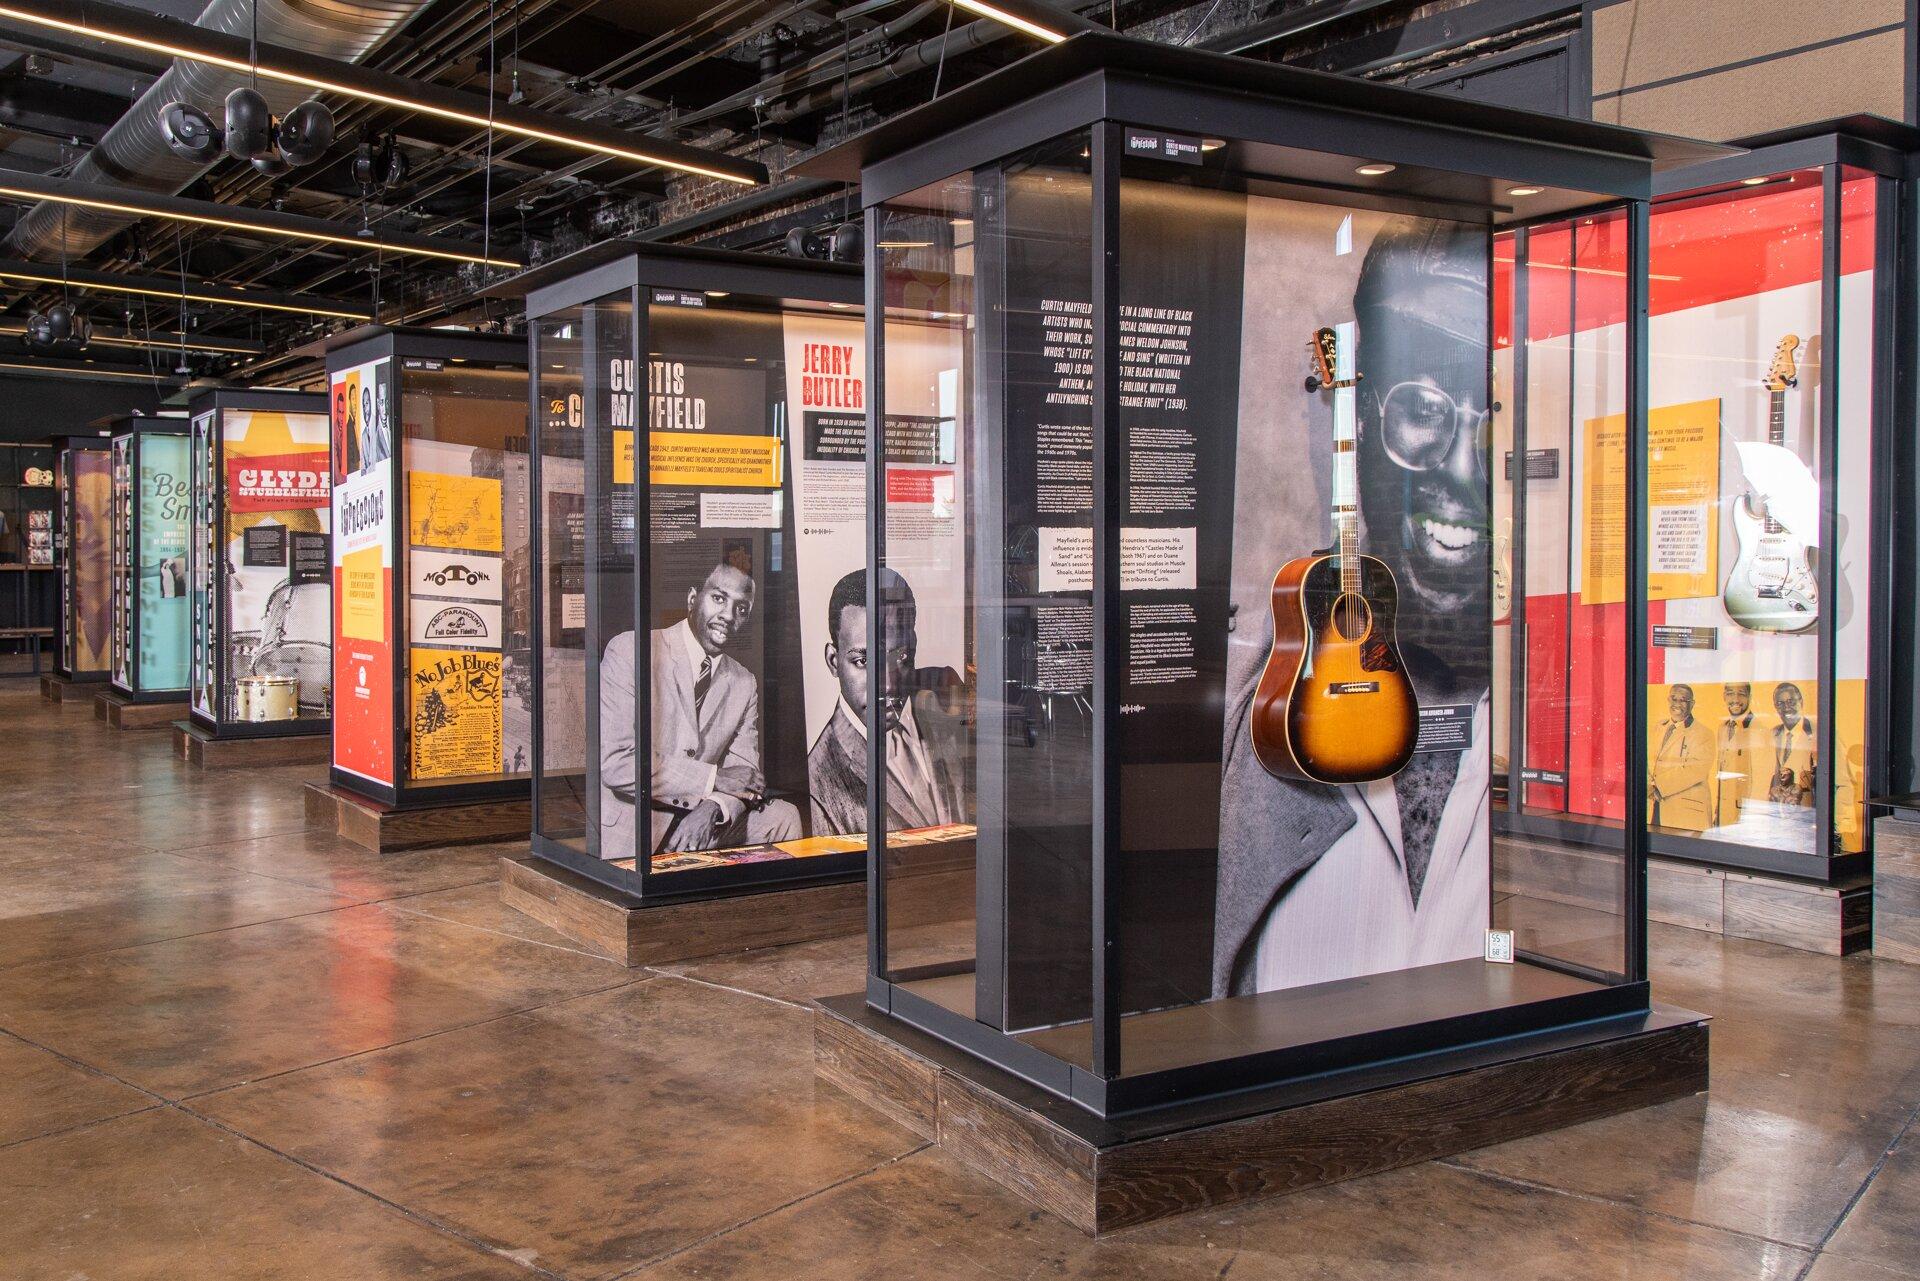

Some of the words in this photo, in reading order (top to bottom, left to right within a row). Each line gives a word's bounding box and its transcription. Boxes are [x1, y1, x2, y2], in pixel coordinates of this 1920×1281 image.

[1040, 300, 1063, 312] CURTIS
[1064, 302, 1092, 314] MAYFIELD
[1125, 306, 1132, 317] IN
[1132, 307, 1137, 317] A
[1138, 307, 1153, 318] LONG
[1153, 308, 1167, 319] LINE
[1167, 309, 1174, 320] OF
[1174, 310, 1193, 321] BLACK
[1042, 315, 1068, 327] ARTISTS
[1068, 317, 1083, 329] WHO
[1138, 322, 1177, 335] COMMENTARY
[1177, 325, 1191, 336] INTO
[1045, 331, 1063, 342] THEIR
[1063, 332, 1083, 345] WORK,
[1120, 336, 1136, 347] AMES
[1136, 337, 1160, 349] WELDON
[1160, 339, 1188, 351] JOHNSON,
[802, 344, 853, 375] JERRY
[1043, 346, 1065, 358] WHOSE
[1066, 347, 1082, 359] "LIFT
[1123, 351, 1136, 362] AND
[1136, 352, 1154, 363] SING"
[1155, 353, 1183, 365] (WRITTEN
[1183, 355, 1191, 365] IN
[610, 358, 685, 395] CUTIS
[1053, 362, 1073, 375] 1900)
[1074, 364, 1081, 374] IS
[1124, 366, 1135, 377] THE
[1135, 367, 1153, 378] BLACK
[1154, 368, 1181, 380] NATIONAL
[803, 376, 862, 408] BUTLER
[1059, 378, 1085, 391] ANTHEM,
[1123, 381, 1148, 394] HOLIDAY,
[1149, 383, 1165, 394] WITH
[1165, 383, 1177, 394] HER
[550, 399, 566, 414] To
[611, 393, 706, 430] MFIELD
[1046, 392, 1089, 406] ANTILYNCHING
[1143, 398, 1164, 409] FRUIT"
[1164, 399, 1188, 412] (1938).
[341, 489, 384, 536] IMPRESSIONS
[431, 609, 483, 628] ABC-PARAMOUNT
[434, 657, 461, 681] Job
